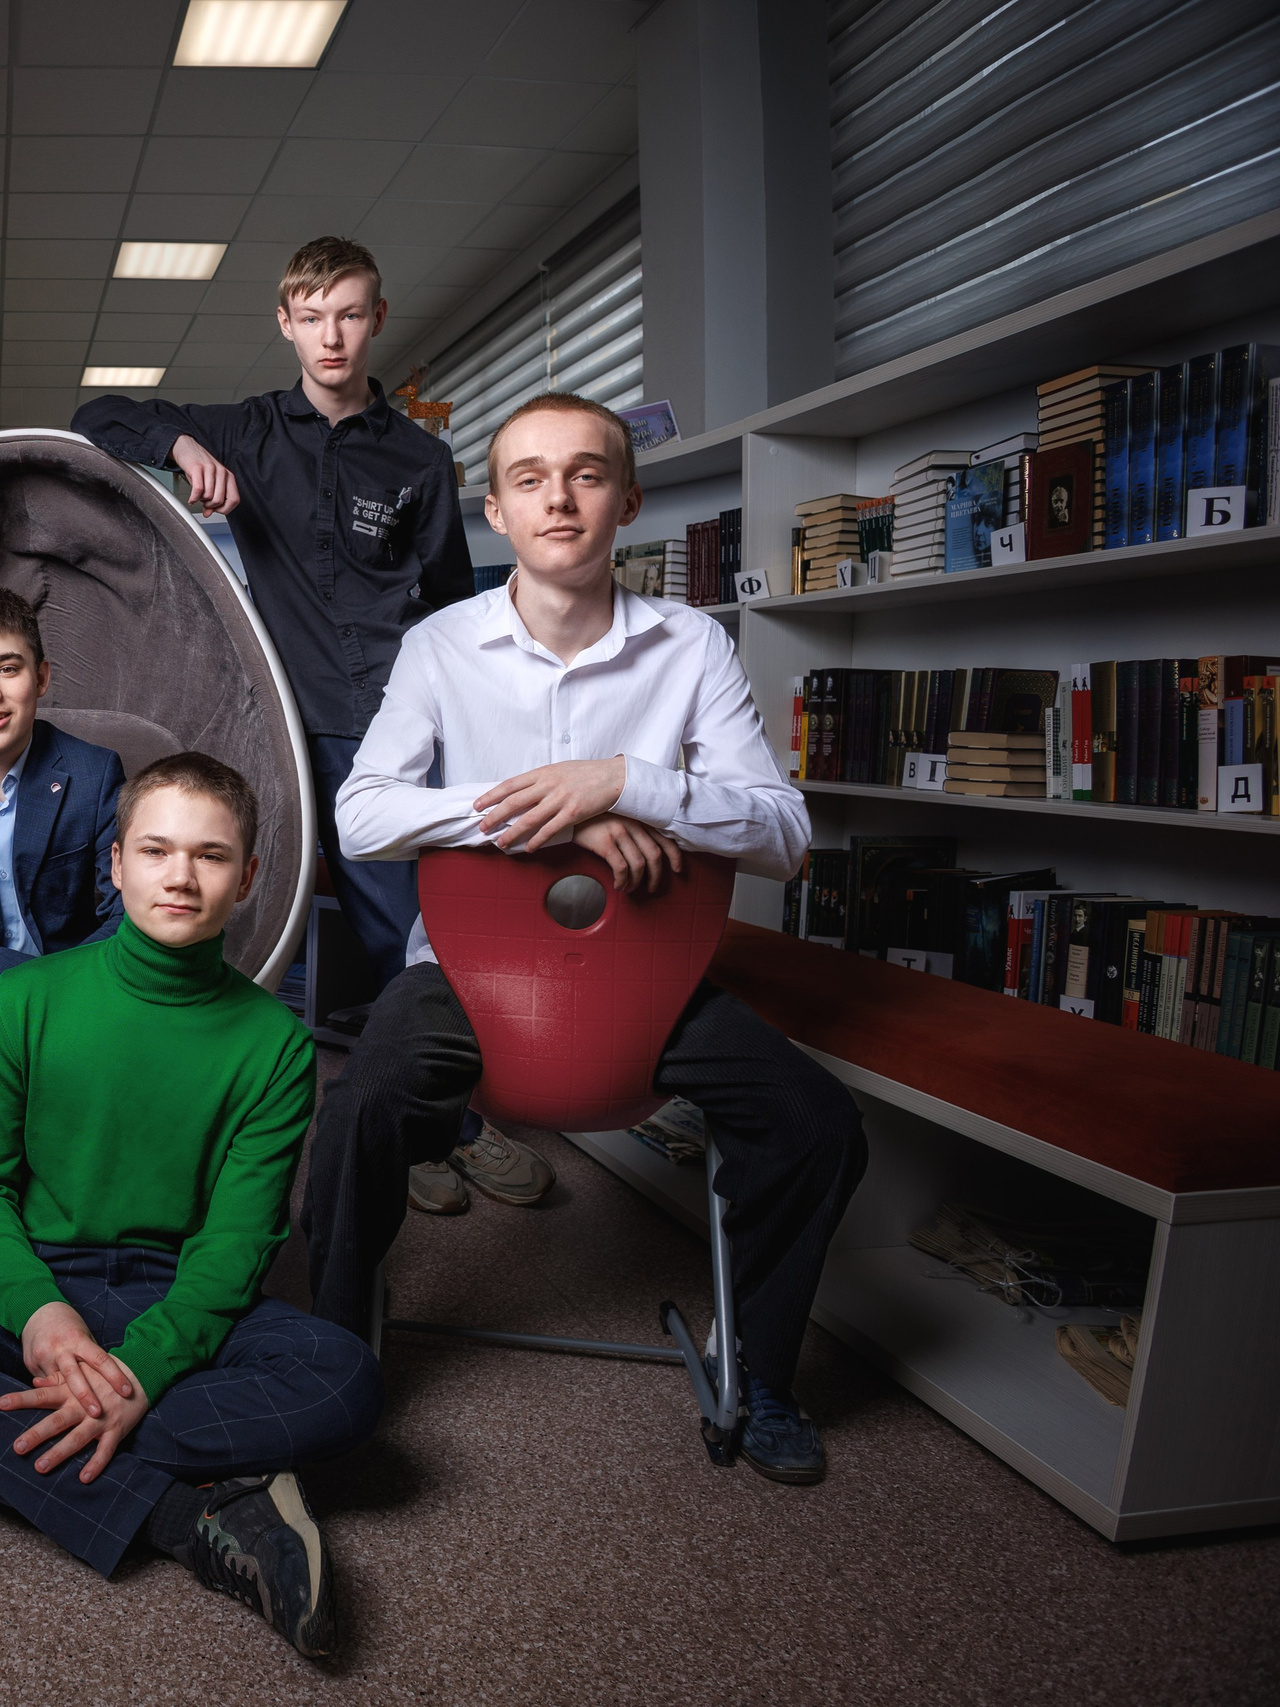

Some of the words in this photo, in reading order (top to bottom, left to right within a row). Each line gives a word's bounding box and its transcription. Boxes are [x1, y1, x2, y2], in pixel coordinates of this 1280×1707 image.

[352, 506, 359, 516] &
[362, 509, 380, 521] GET
[383, 504, 394, 515] UP
[950, 499, 977, 511] МАРИНА
[950, 507, 982, 518] ЦВЕТАЕВА
[1200, 497, 1231, 526] Б
[1000, 534, 1013, 552] Ч
[838, 566, 848, 588] Х
[869, 556, 877, 579] Ц
[740, 577, 762, 596] Ф
[908, 762, 916, 778] В
[1231, 777, 1251, 803] Д
[1005, 947, 1013, 971] Уэллс
[1130, 932, 1140, 975] ХЕМИНГУЭЙ
